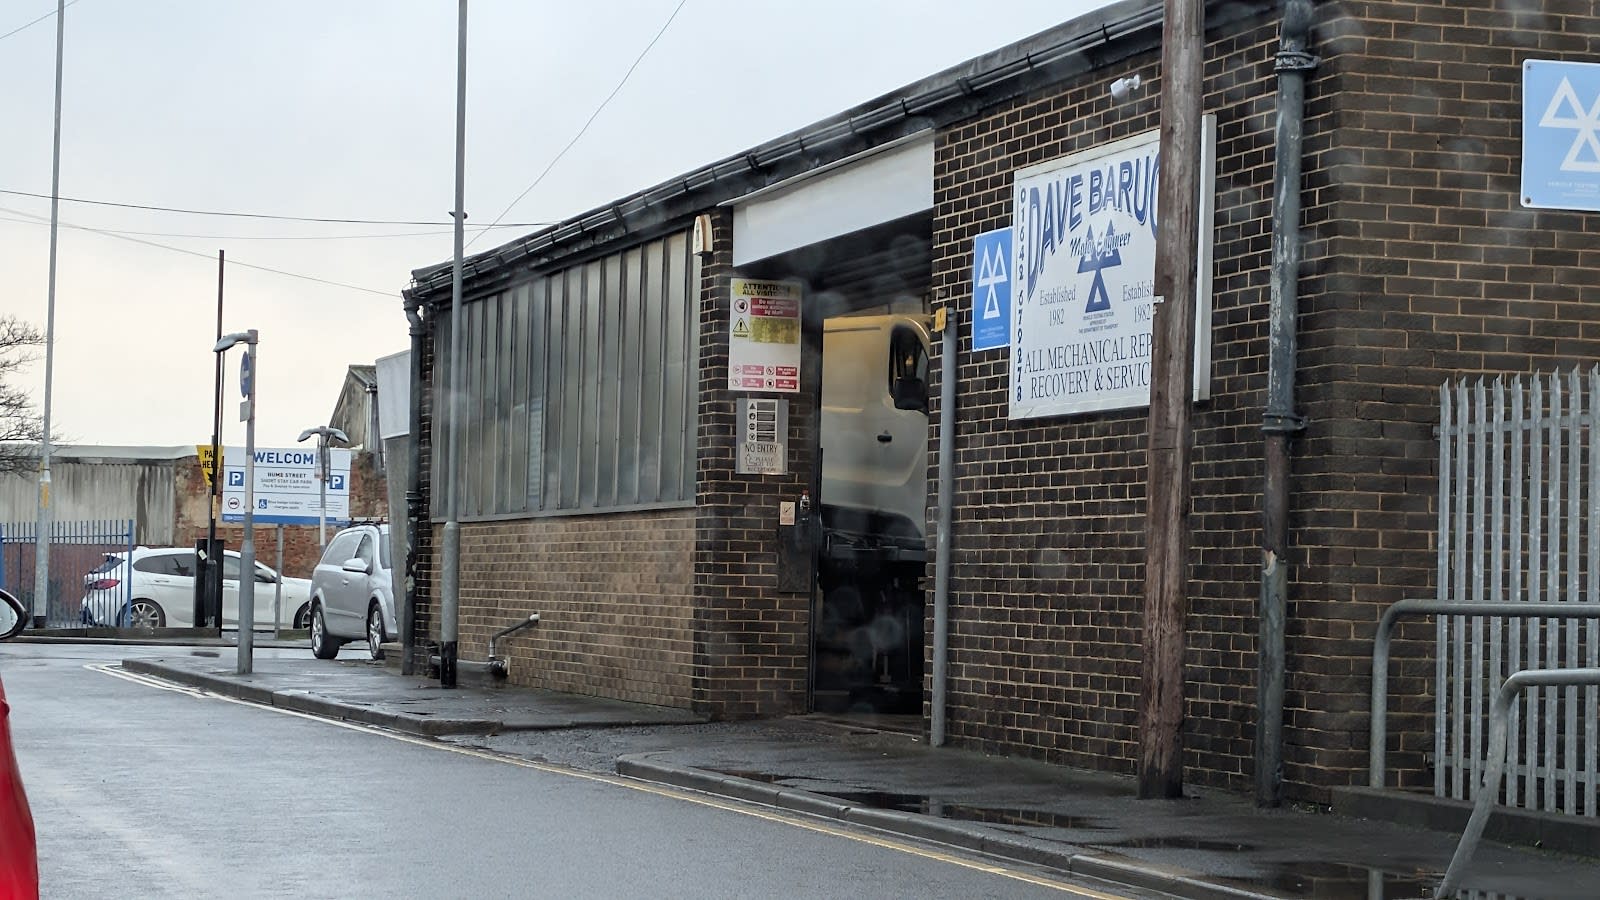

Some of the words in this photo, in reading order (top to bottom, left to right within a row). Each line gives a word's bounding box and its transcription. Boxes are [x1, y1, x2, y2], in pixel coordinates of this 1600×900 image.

[1027, 174, 1083, 304] DAVE
[1070, 235, 1096, 258] Motor
[1097, 229, 1131, 258] Engineer
[1040, 284, 1075, 305] Established
[1050, 308, 1064, 326] 1982
[1134, 304, 1150, 323] 1982
[1024, 349, 1045, 373] ALL
[1048, 336, 1127, 370] MECHANICAL
[1030, 369, 1091, 399] RECOVERY
[1094, 367, 1103, 391] &
[745, 443, 755, 453] NO
[757, 443, 777, 453] ENTRY
[231, 473, 241, 485] P
[332, 476, 342, 488] P
